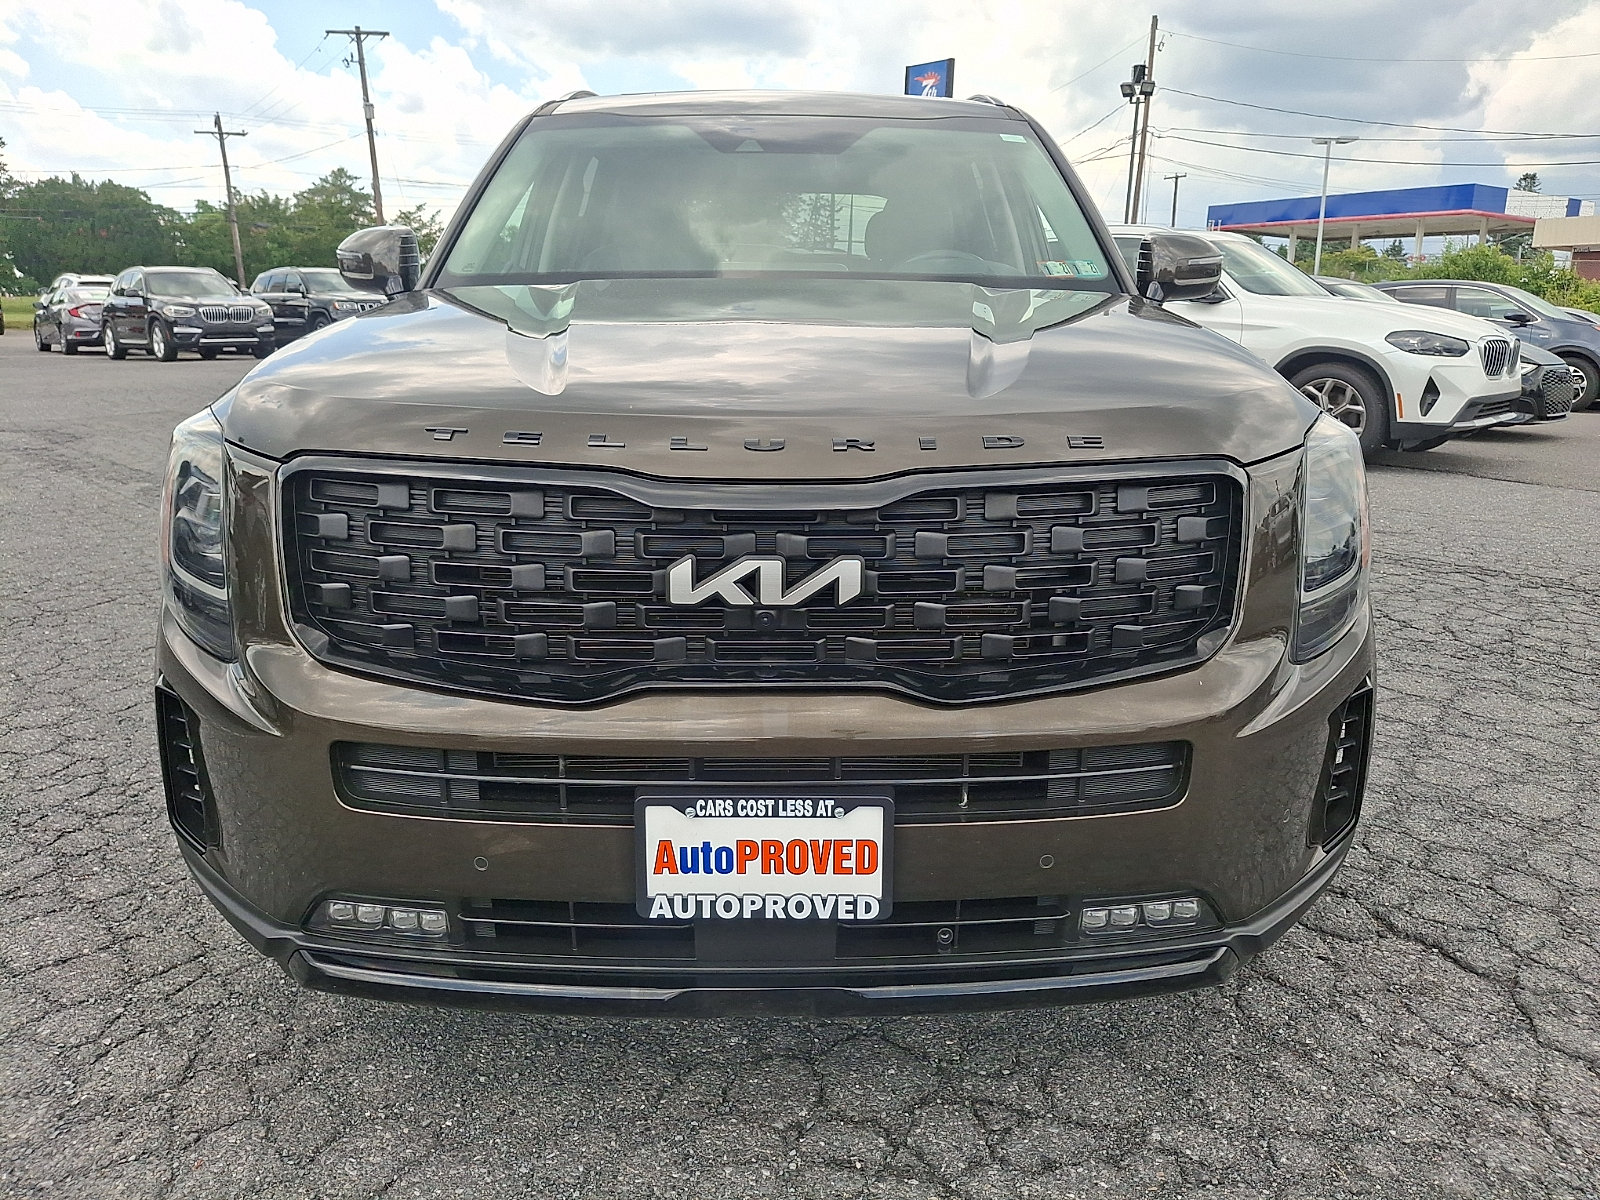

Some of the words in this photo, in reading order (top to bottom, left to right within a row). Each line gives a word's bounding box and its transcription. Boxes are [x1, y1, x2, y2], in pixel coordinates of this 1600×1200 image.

[424, 427, 1105, 452] TELLURIDE
[667, 553, 865, 607] KIA
[696, 799, 734, 817] CARS
[737, 799, 775, 817] COST
[778, 799, 812, 817] LESS
[816, 799, 835, 817] AT
[653, 839, 879, 875] AutoPROVED
[650, 893, 880, 919] AUTOPROVED
